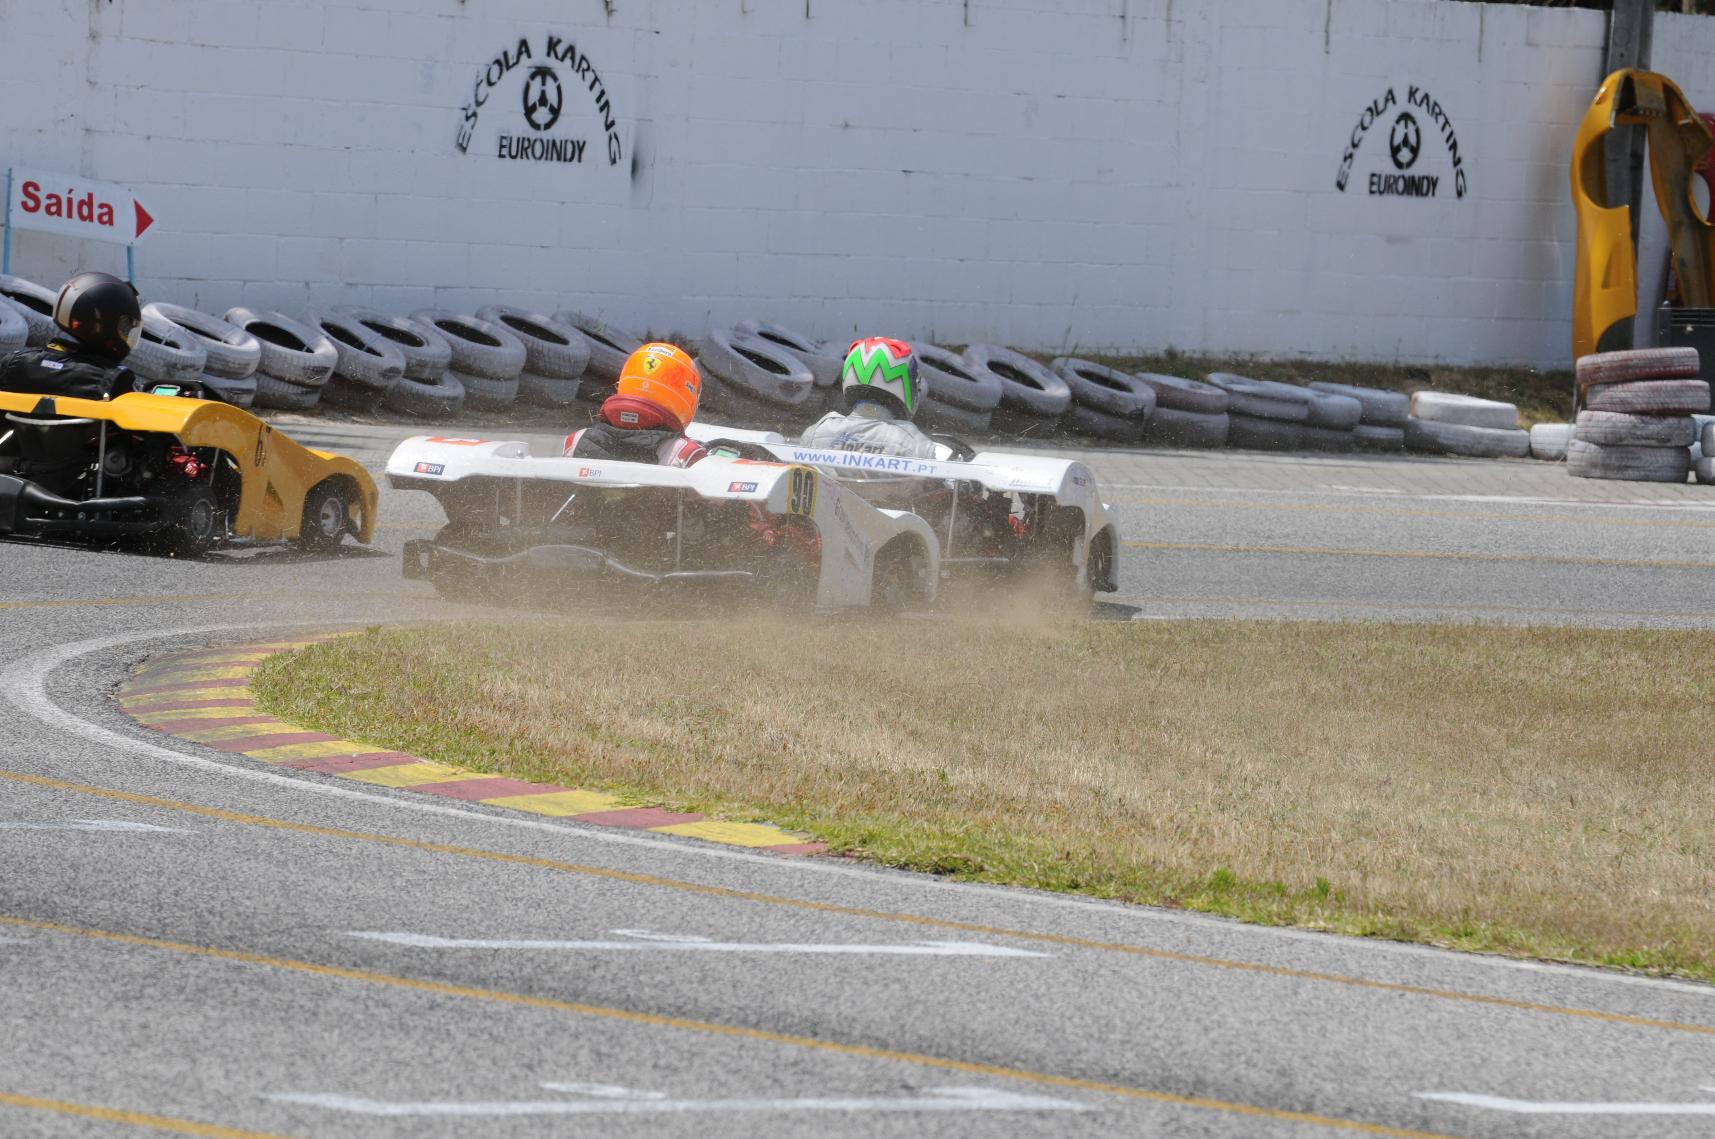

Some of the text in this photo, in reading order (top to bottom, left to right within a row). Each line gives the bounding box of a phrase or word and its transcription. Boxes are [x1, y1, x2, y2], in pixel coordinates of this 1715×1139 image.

[456, 36, 622, 166] ESCOLA KARTING
[498, 135, 587, 163] EUROINDY
[1335, 84, 1467, 199] ESCOLA KARTING
[21, 180, 115, 227] Saída
[1368, 173, 1439, 197] EUROINDY
[428, 464, 442, 474] BPI
